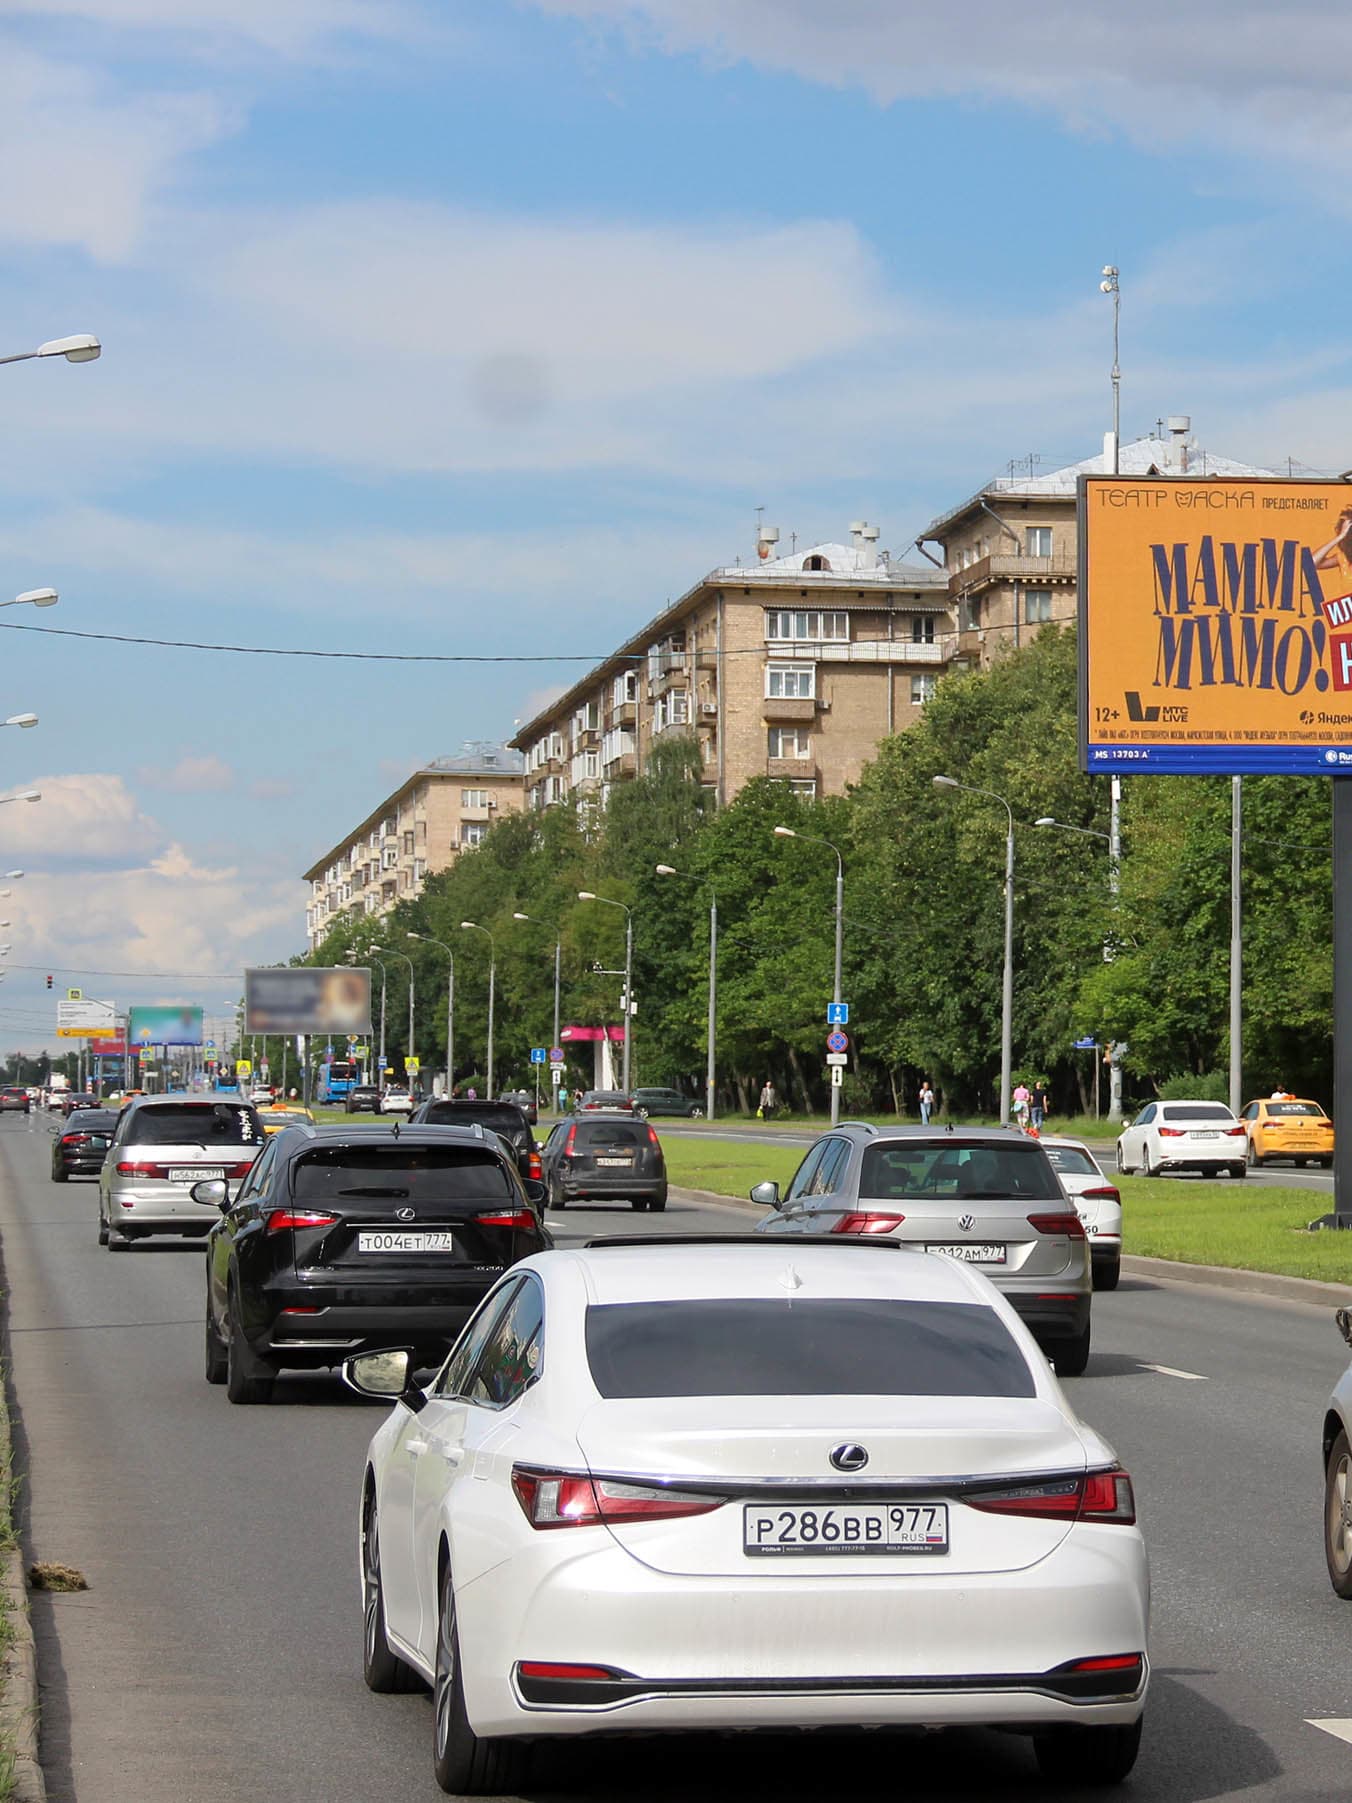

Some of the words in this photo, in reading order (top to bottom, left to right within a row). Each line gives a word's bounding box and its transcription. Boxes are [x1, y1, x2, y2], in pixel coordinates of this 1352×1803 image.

[1096, 489, 1168, 508] ТЕАТР
[1262, 497, 1329, 511] ПРЕДСТАВЛЯЕТ
[1149, 535, 1326, 618] МАММА
[1152, 612, 1329, 696] МИМО!
[1095, 707, 1120, 723] 12+
[1163, 714, 1188, 723] LIVE
[426, 1233, 448, 1245] 777
[983, 1245, 1002, 1257] 977
[890, 1508, 937, 1532] 977
[901, 1533, 925, 1542] RUS
